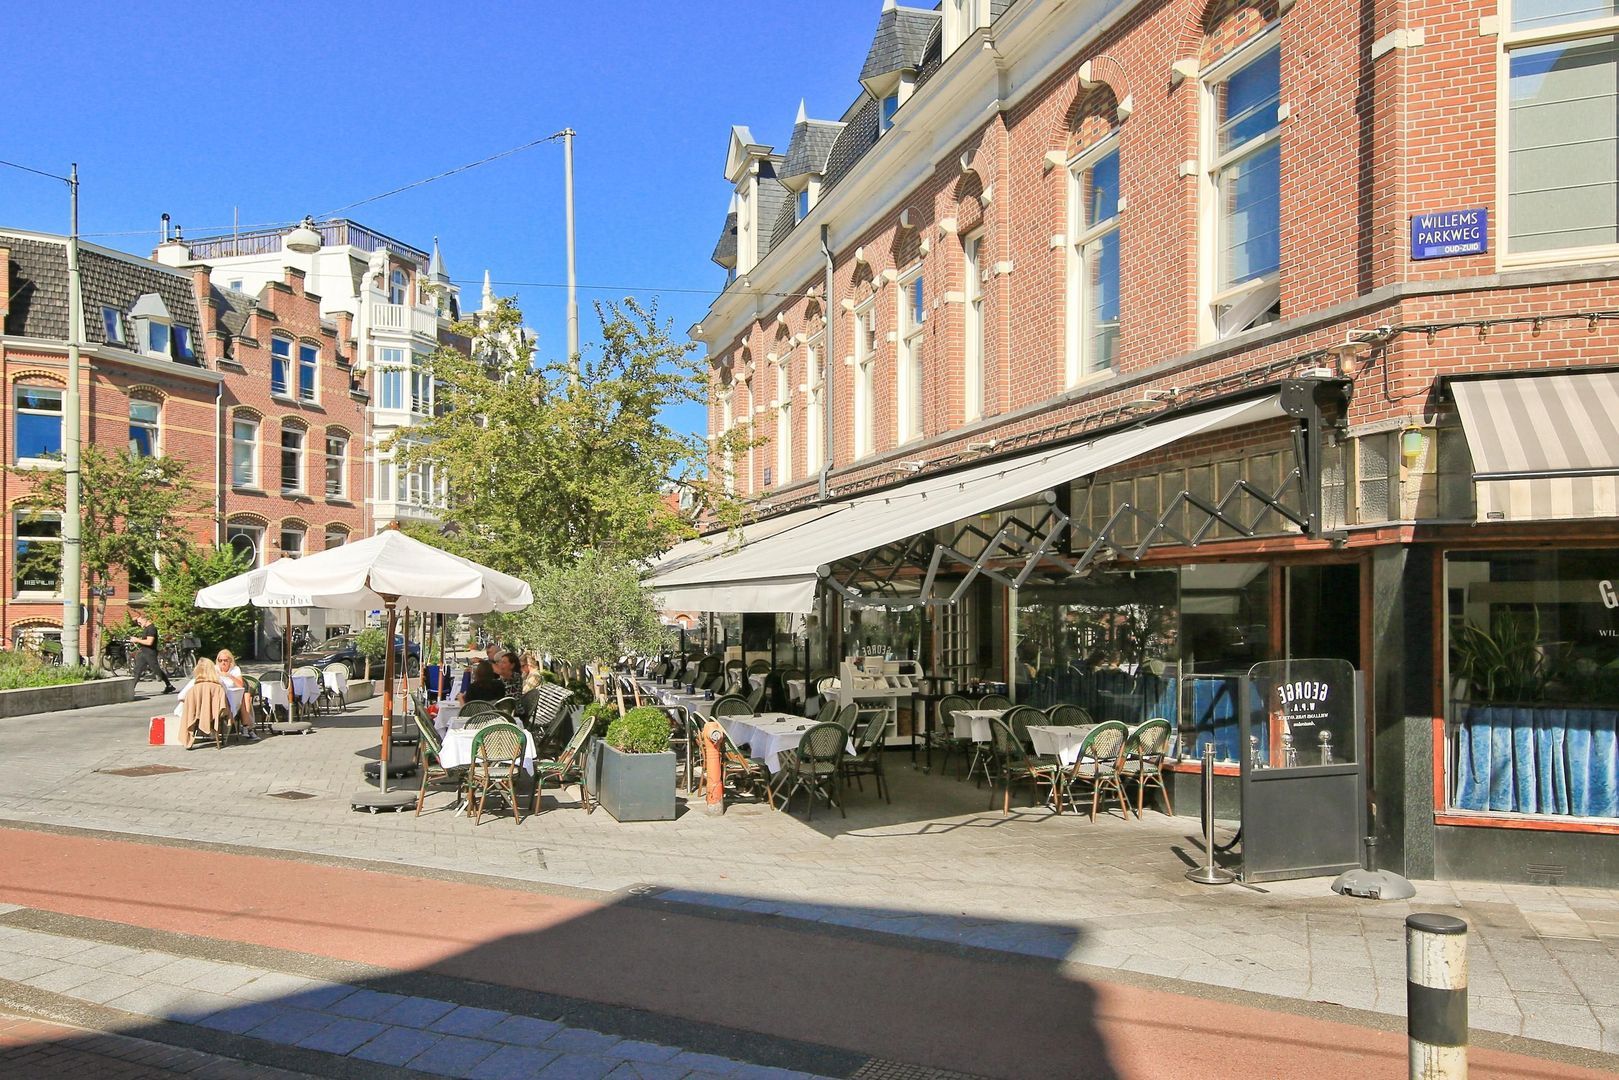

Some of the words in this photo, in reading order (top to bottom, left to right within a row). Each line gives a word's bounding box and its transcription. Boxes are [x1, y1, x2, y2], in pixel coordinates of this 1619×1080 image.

[1421, 212, 1478, 229] WILLEMS
[1418, 227, 1480, 245] PARKWEG
[1444, 243, 1478, 254] OUD-ZUID
